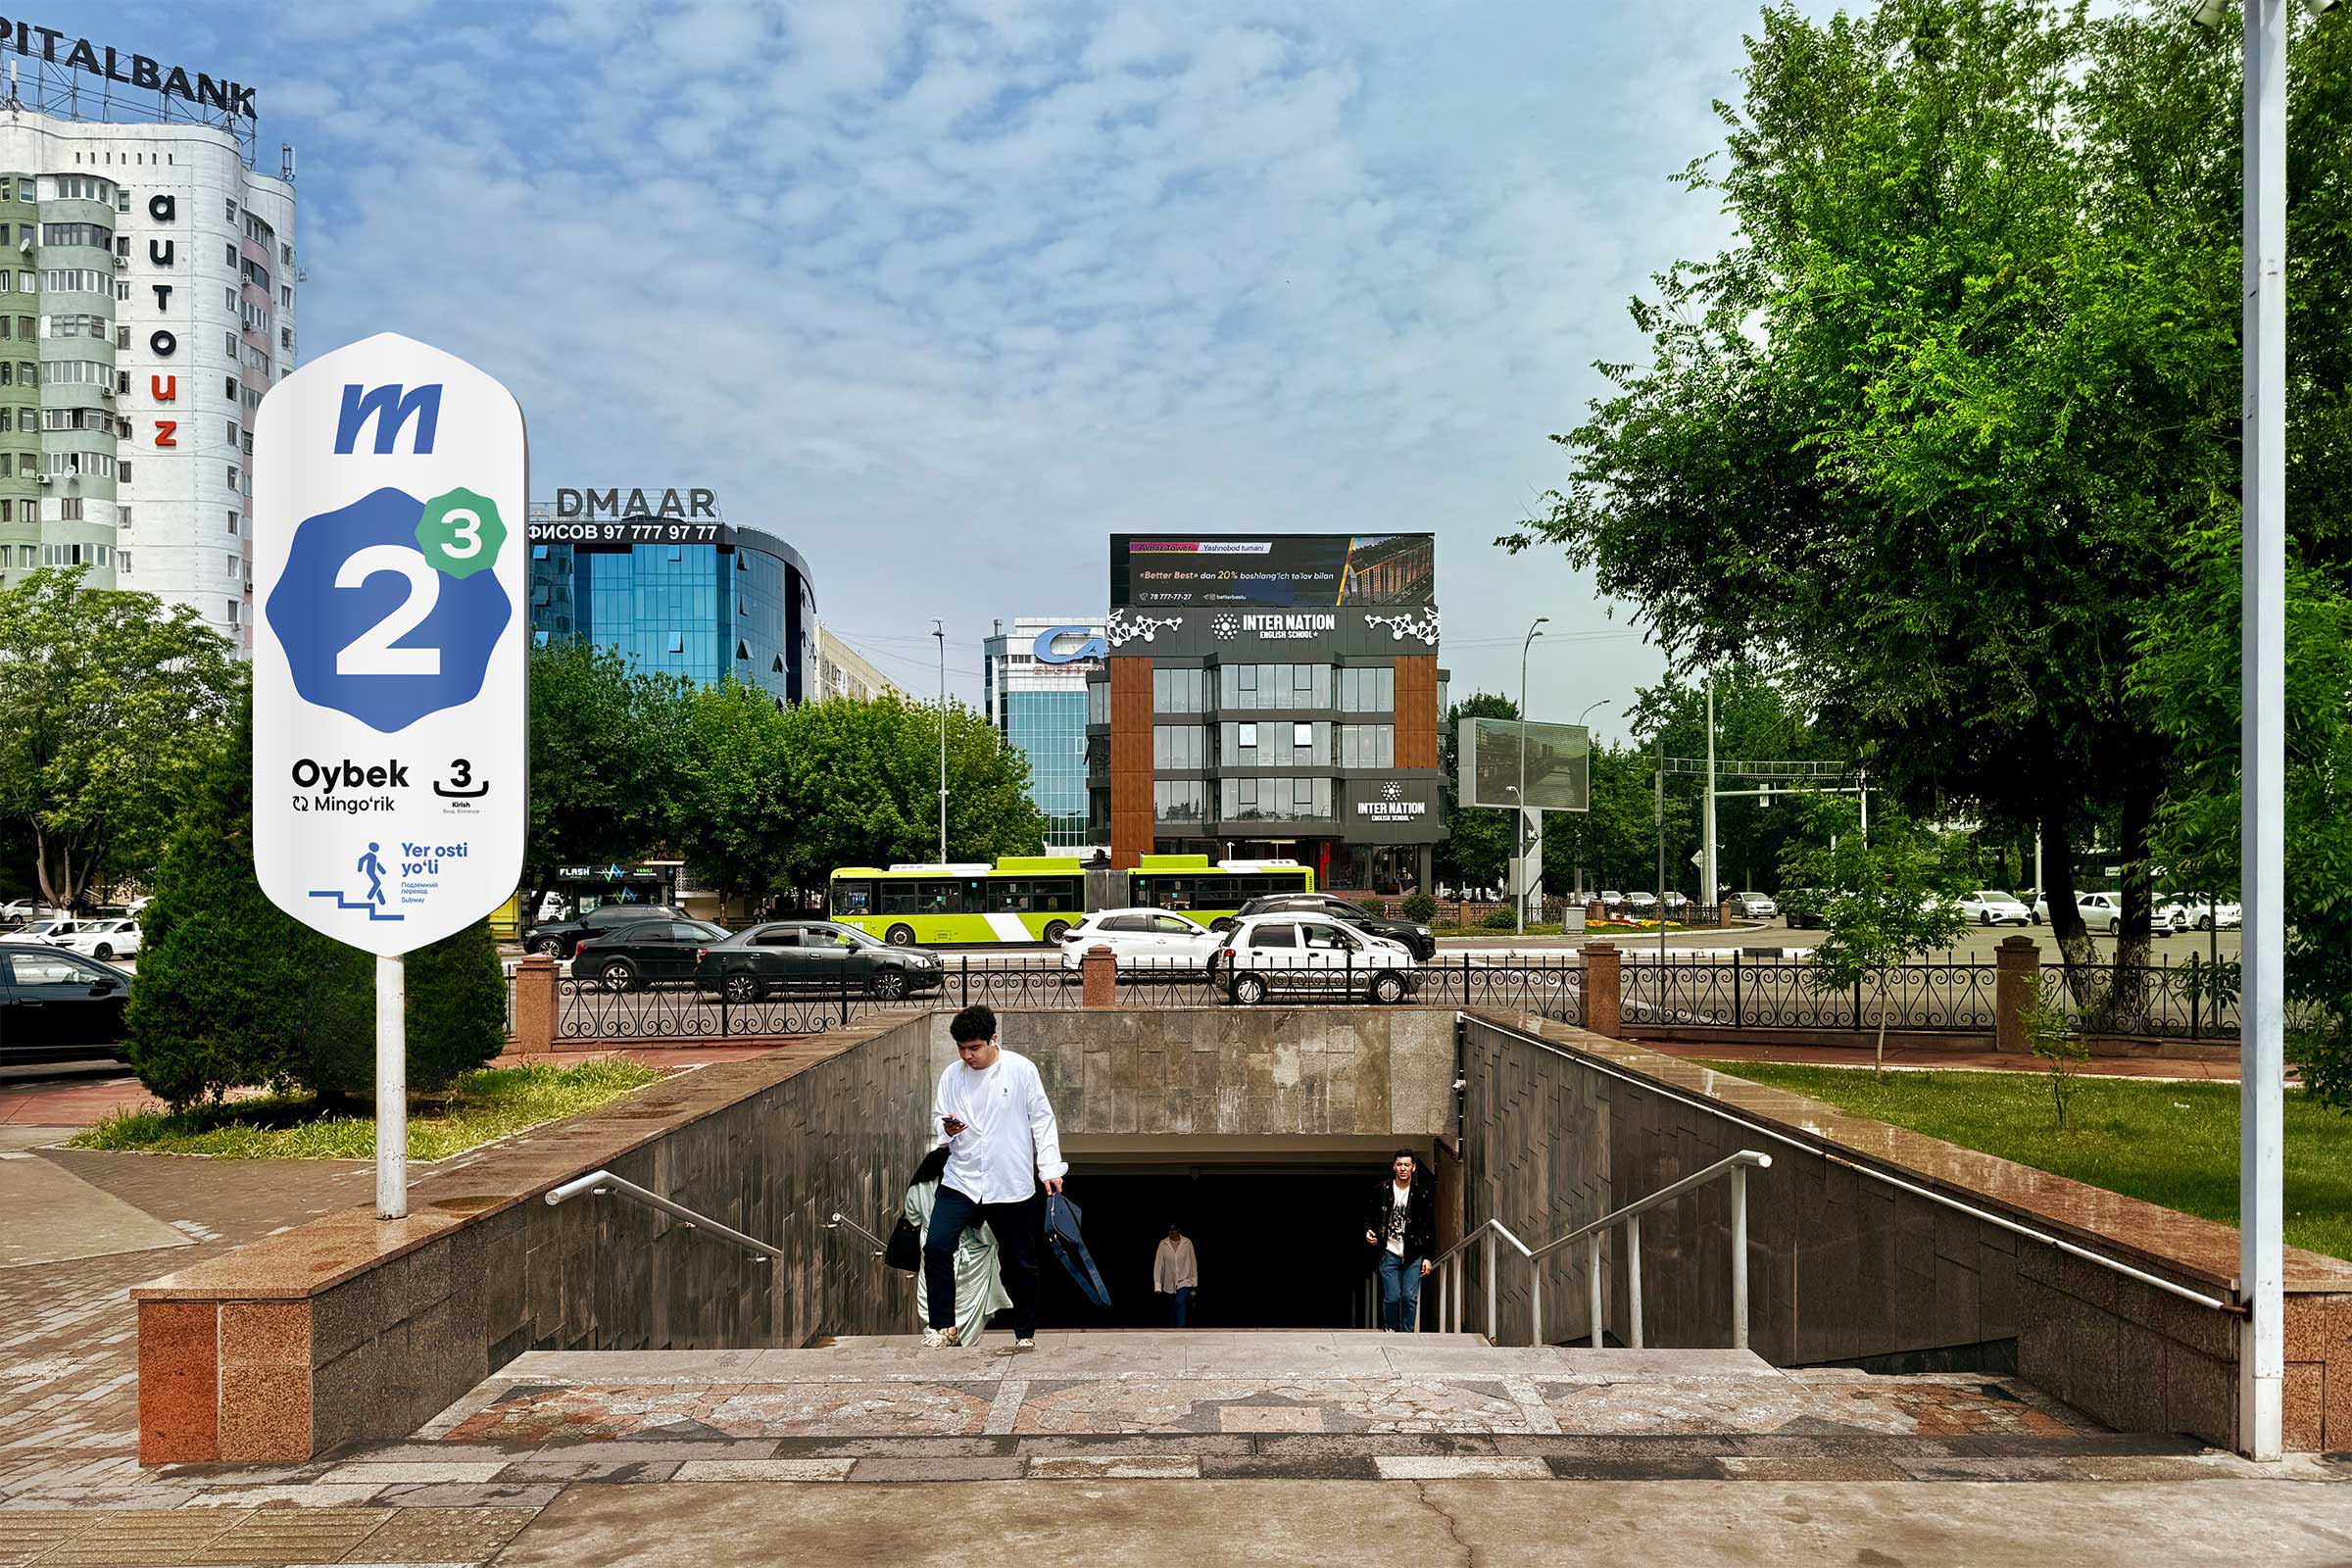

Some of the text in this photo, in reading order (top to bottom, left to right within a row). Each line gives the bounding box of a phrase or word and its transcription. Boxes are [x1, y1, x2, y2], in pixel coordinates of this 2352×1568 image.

[557, 487, 716, 517] DMAAR
[440, 508, 482, 559] 3
[604, 524, 625, 540] 97
[631, 524, 662, 540] 777
[668, 524, 690, 540] 97
[697, 524, 717, 540] 77
[1217, 570, 1238, 580] 20%
[334, 544, 441, 675] 2
[1243, 613, 1336, 631] INTER NATION
[1259, 630, 1313, 639] ENGLISH SCHOOL
[291, 758, 410, 795] Oybek
[450, 759, 472, 788] 3
[1357, 802, 1426, 814] INTER NATION
[401, 842, 467, 858] Yer osti
[560, 867, 590, 876] FLASH
